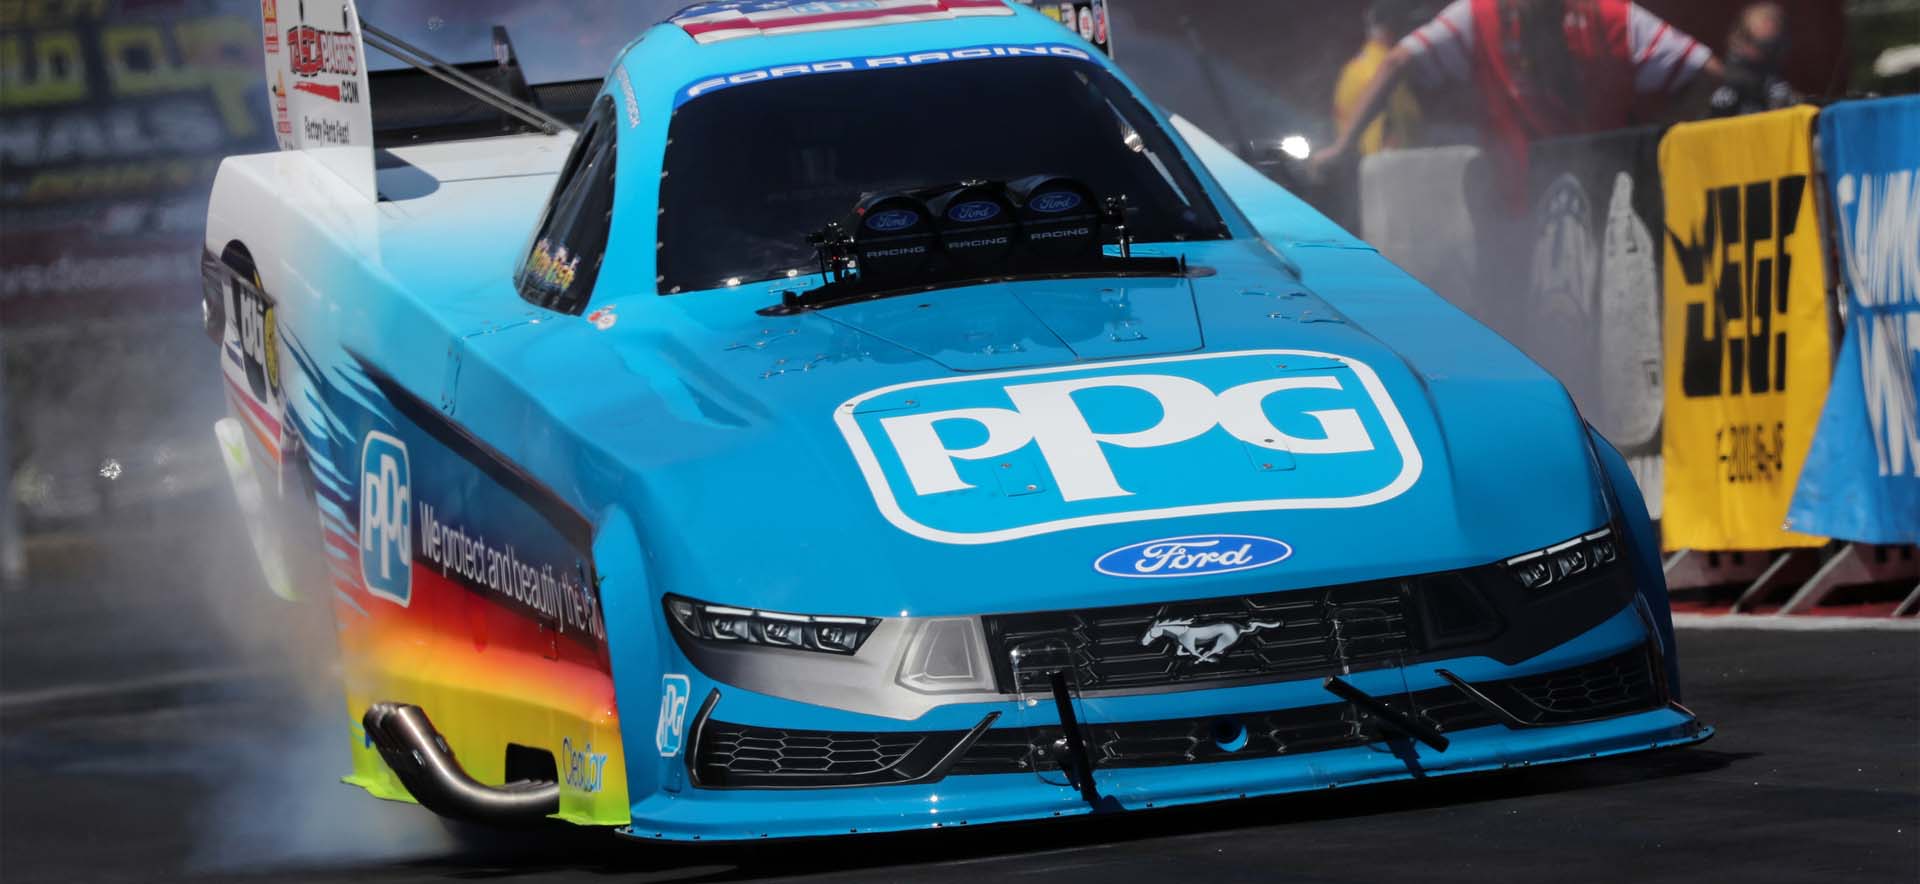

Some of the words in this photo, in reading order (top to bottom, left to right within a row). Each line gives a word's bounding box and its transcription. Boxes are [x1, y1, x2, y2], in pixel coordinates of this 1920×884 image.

[687, 60, 854, 97] FORD
[866, 46, 1090, 68] RACING
[958, 204, 990, 219] Ford
[1039, 195, 1071, 210] Ford
[878, 212, 907, 227] Ford
[949, 237, 1008, 249] RACING
[1030, 227, 1089, 240] RACING
[866, 246, 926, 258] RACING
[881, 374, 1374, 502] PPG
[365, 454, 409, 580] PPG
[419, 501, 441, 563] We
[442, 524, 487, 586] protect
[488, 544, 513, 597] and
[511, 546, 564, 633] beautify
[1134, 539, 1253, 573] Ford
[660, 684, 686, 749] PPG
